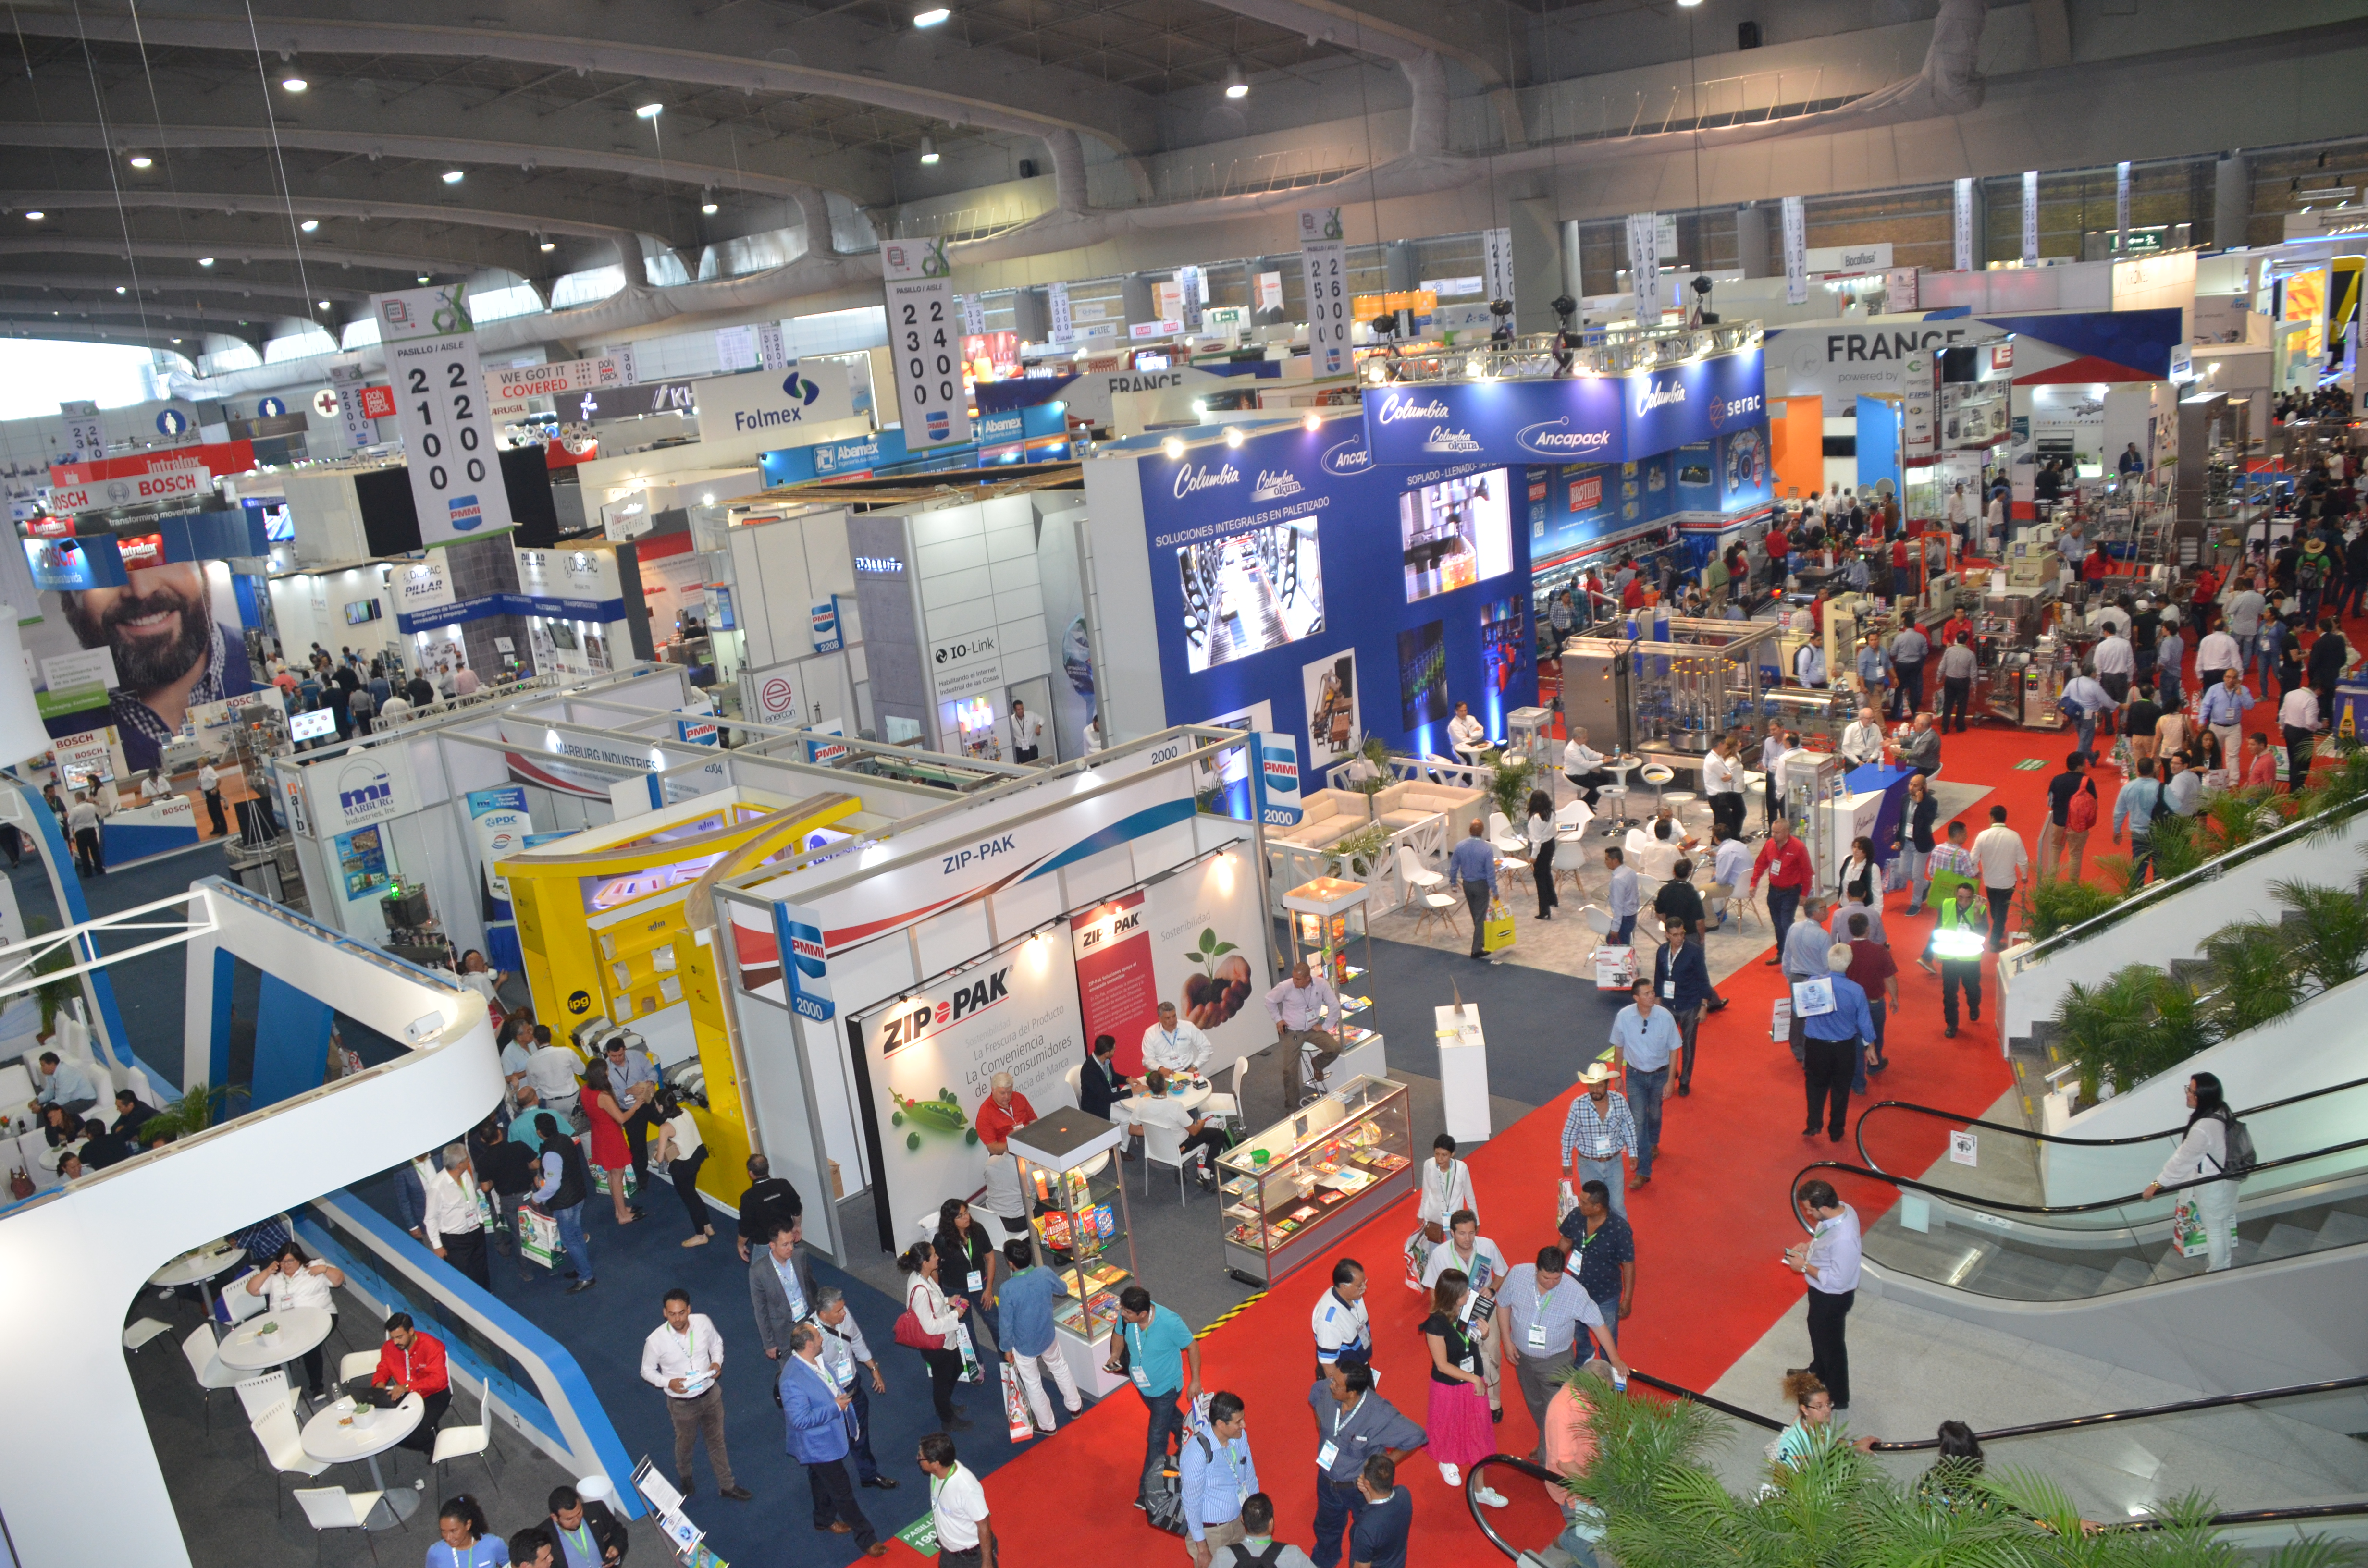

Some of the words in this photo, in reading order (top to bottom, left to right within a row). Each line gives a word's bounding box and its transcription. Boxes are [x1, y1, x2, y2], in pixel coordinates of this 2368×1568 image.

[896, 285, 921, 294] PASILLO
[1329, 258, 1344, 341] 2600
[1312, 260, 1326, 343] 2500
[1094, 325, 1110, 335] FILTEC
[1164, 323, 1178, 331] ULINE
[398, 345, 433, 357] PASILLO
[441, 341, 464, 352] AISLE
[764, 335, 773, 370] 3100
[774, 334, 783, 369] 3200
[903, 304, 927, 404] 2300
[930, 301, 954, 401] 2400
[501, 373, 520, 383] WE
[526, 368, 551, 381] GOT
[555, 366, 565, 376] IT
[598, 359, 615, 371] poly
[600, 372, 618, 383] pack
[1108, 374, 1182, 393] FRANCE
[1838, 371, 1884, 383] powered
[1886, 371, 1899, 382] by
[366, 390, 384, 405] poly
[503, 379, 567, 398] COVERED
[1636, 378, 1686, 417] Columbia
[342, 391, 356, 431] 2500
[369, 403, 390, 416] pack
[1379, 393, 1450, 424] Columbia
[1727, 395, 1761, 416] serac
[408, 368, 447, 490] 2100
[447, 362, 486, 482] 2200
[735, 407, 802, 431] Folmex
[928, 421, 949, 430] PMMI
[985, 416, 1023, 434] Abamex
[1429, 425, 1471, 444] Columbia
[1536, 430, 1610, 447] Ancapack
[838, 441, 879, 460] Abamex
[1448, 441, 1478, 453] okura
[147, 455, 201, 474] intralox
[139, 474, 196, 497] BOSCH
[1174, 463, 1240, 499] Columbia
[1257, 469, 1294, 493] Columbia
[1407, 470, 1440, 485] SOPLADO
[1273, 481, 1301, 497] okura
[1571, 480, 1601, 503] BROTHER
[110, 511, 159, 527] transforming
[160, 505, 201, 519] movement
[450, 506, 481, 520] PMMI
[1156, 525, 1214, 547] SOLUCIONES
[1216, 512, 1269, 534] INTEGRALES
[1270, 509, 1282, 521] EN
[1283, 496, 1330, 518] PALETIZADO
[612, 517, 645, 538] SCIENTIFIC
[569, 557, 598, 573] DISPAC
[405, 580, 442, 597] PILLAR
[413, 615, 438, 625] envasado
[812, 612, 834, 624] PMMI
[820, 640, 839, 652] 2208
[950, 637, 995, 660] IO-Link
[939, 674, 969, 687] Habilitando
[976, 666, 997, 677] Internet
[940, 684, 965, 696] Industrial
[983, 674, 999, 684] Cosas
[226, 696, 255, 709] BOSC
[765, 709, 796, 723] enercon
[56, 733, 94, 749] BOSCH
[686, 723, 716, 740] PMMI
[75, 747, 103, 760] BOSCH
[556, 743, 600, 761] MARBURG
[602, 751, 658, 772] INDUSTRIES
[815, 744, 846, 761] PMMI
[1151, 746, 1179, 765] 2000
[1264, 760, 1297, 777] PMMI
[340, 773, 392, 809] mi
[162, 803, 191, 816] BOSCH
[287, 782, 306, 834] nalb
[344, 797, 394, 818] MARBURG
[345, 809, 383, 827] Industries,
[384, 806, 396, 815] Inc
[1264, 808, 1293, 826] 2000
[496, 815, 518, 825] PDC
[1854, 812, 1875, 836] Columbia
[943, 833, 1016, 875] ZIP-PAK
[1083, 928, 1103, 948] ZIP
[1114, 912, 1139, 934] PAK
[1160, 910, 1211, 942] Sostenibilidad
[791, 938, 825, 960] PMMI
[1089, 982, 1107, 993] envasado
[1107, 973, 1125, 985] sostenible
[1102, 969, 1122, 981] Soluciones
[1122, 965, 1133, 974] apoya
[568, 996, 589, 1011] ipg
[796, 996, 824, 1019] 2000
[883, 1005, 931, 1055] ZIP
[953, 967, 1009, 1022] PAK
[965, 1017, 1011, 1049] Sostenibilidad
[974, 1050, 984, 1061] La
[985, 1032, 1017, 1056] Frescura
[1019, 1022, 1030, 1037] del
[1032, 1005, 1064, 1030] Producto
[966, 1071, 978, 1085] La
[981, 1034, 1044, 1077] Conveniencia
[975, 1082, 987, 1098] de
[1007, 1036, 1072, 1079] Consumidores
[1036, 1071, 1045, 1081] de
[1047, 1058, 1070, 1077] Marca
[1029, 1081, 1056, 1102] Globales
[914, 1530, 937, 1548] 190
